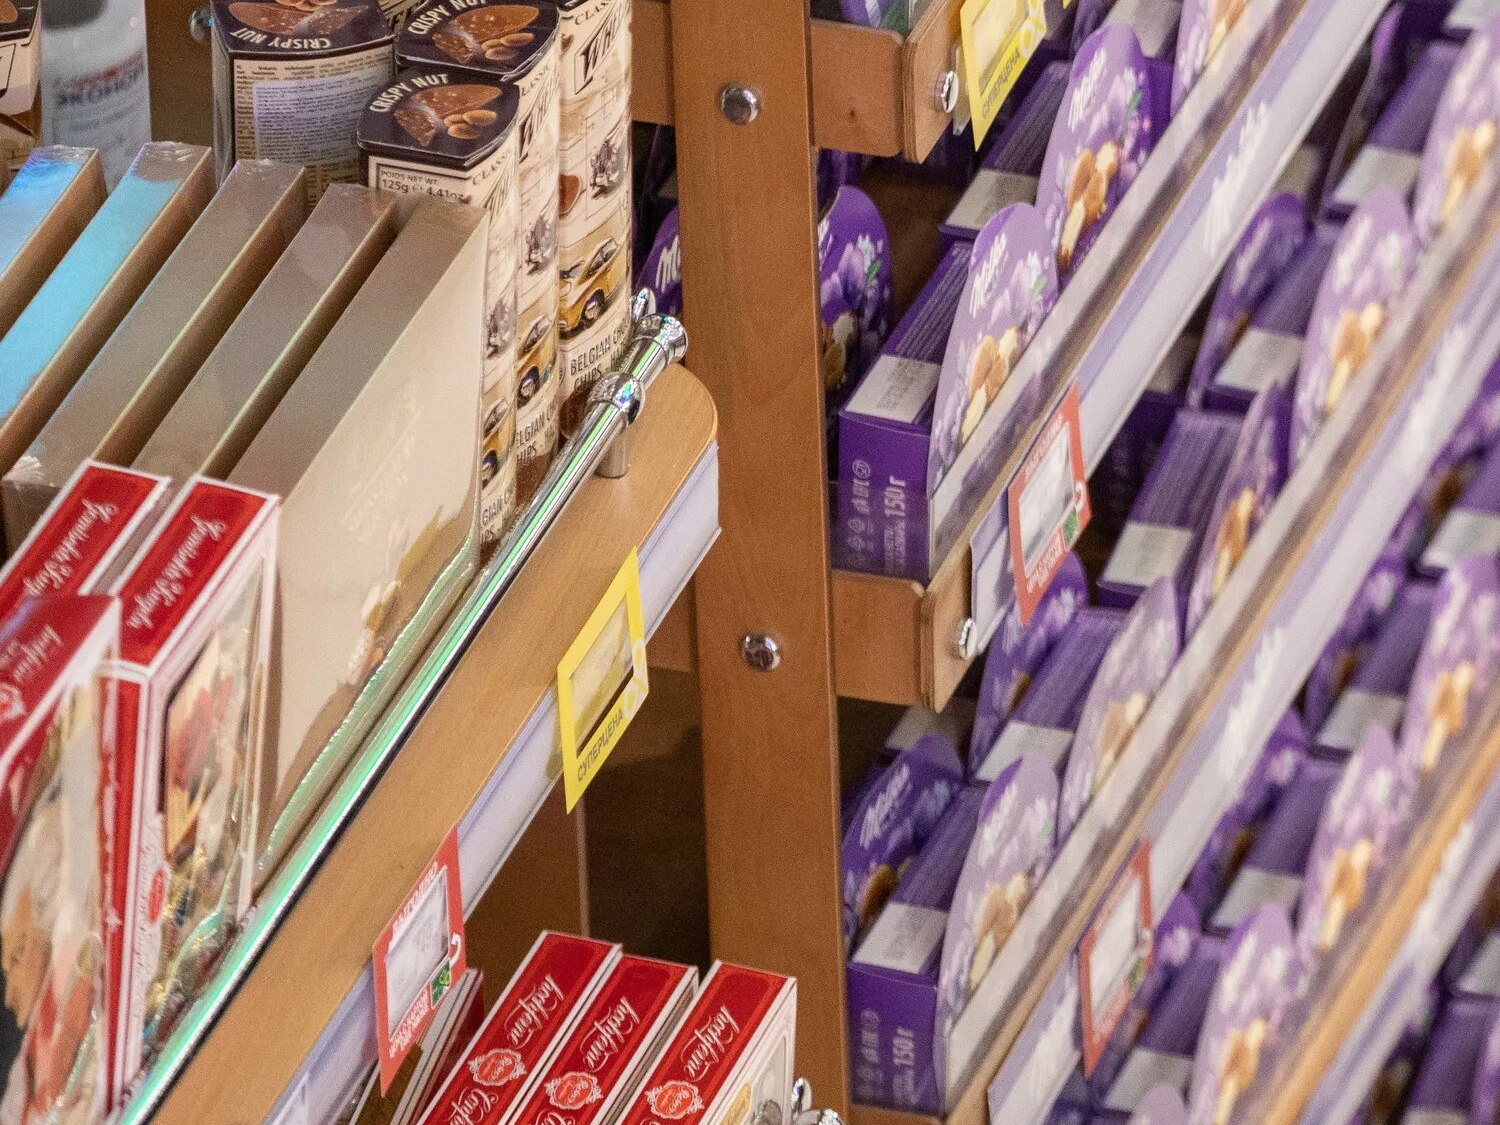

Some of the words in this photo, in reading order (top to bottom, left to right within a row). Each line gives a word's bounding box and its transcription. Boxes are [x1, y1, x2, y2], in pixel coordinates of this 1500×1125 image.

[229, 27, 268, 44] NUT
[407, 4, 451, 36] CRISPY
[268, 37, 332, 50] CRISPY
[368, 81, 413, 113] CRISPY
[411, 73, 449, 89] NUT
[981, 46, 1021, 120] СУПЕРЦЕНА
[382, 179, 409, 194] 125g
[570, 336, 612, 376] BELGIAN
[573, 366, 602, 398] CHIPS
[516, 440, 538, 467] HIPS
[577, 708, 624, 782] СУПЕРЦЕНА
[505, 973, 564, 1048] hochfeine
[582, 995, 641, 1072] hochfeine
[683, 1004, 741, 1081] hochfeine
